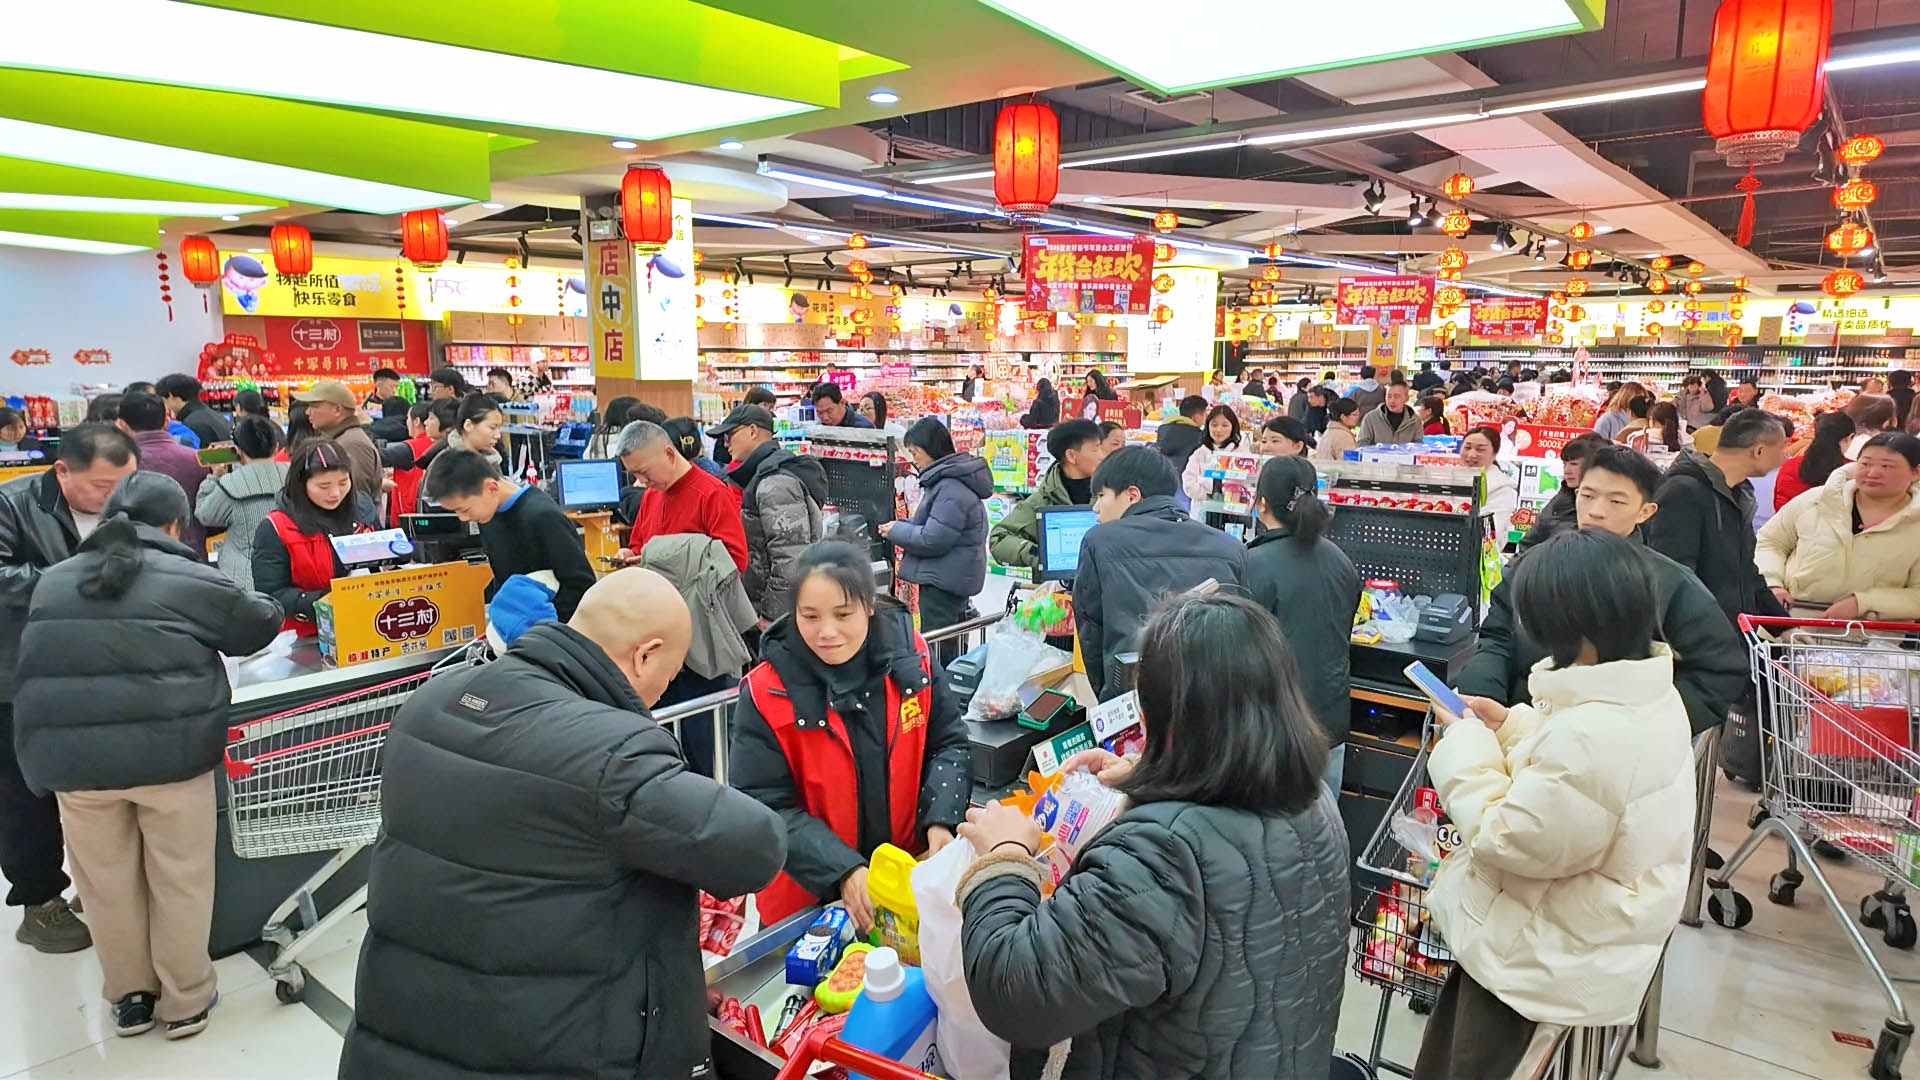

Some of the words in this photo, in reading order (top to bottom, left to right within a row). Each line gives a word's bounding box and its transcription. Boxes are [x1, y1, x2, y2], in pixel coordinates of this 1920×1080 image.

[1035, 249, 1143, 282] 年货会狂欢
[296, 291, 356, 307] 快乐零食
[599, 243, 623, 362] 店中店
[1344, 285, 1427, 305] 年货会狂欢
[1822, 308, 1869, 318] 精选细选
[295, 328, 338, 342] 十三村
[380, 608, 434, 631] 十三村
